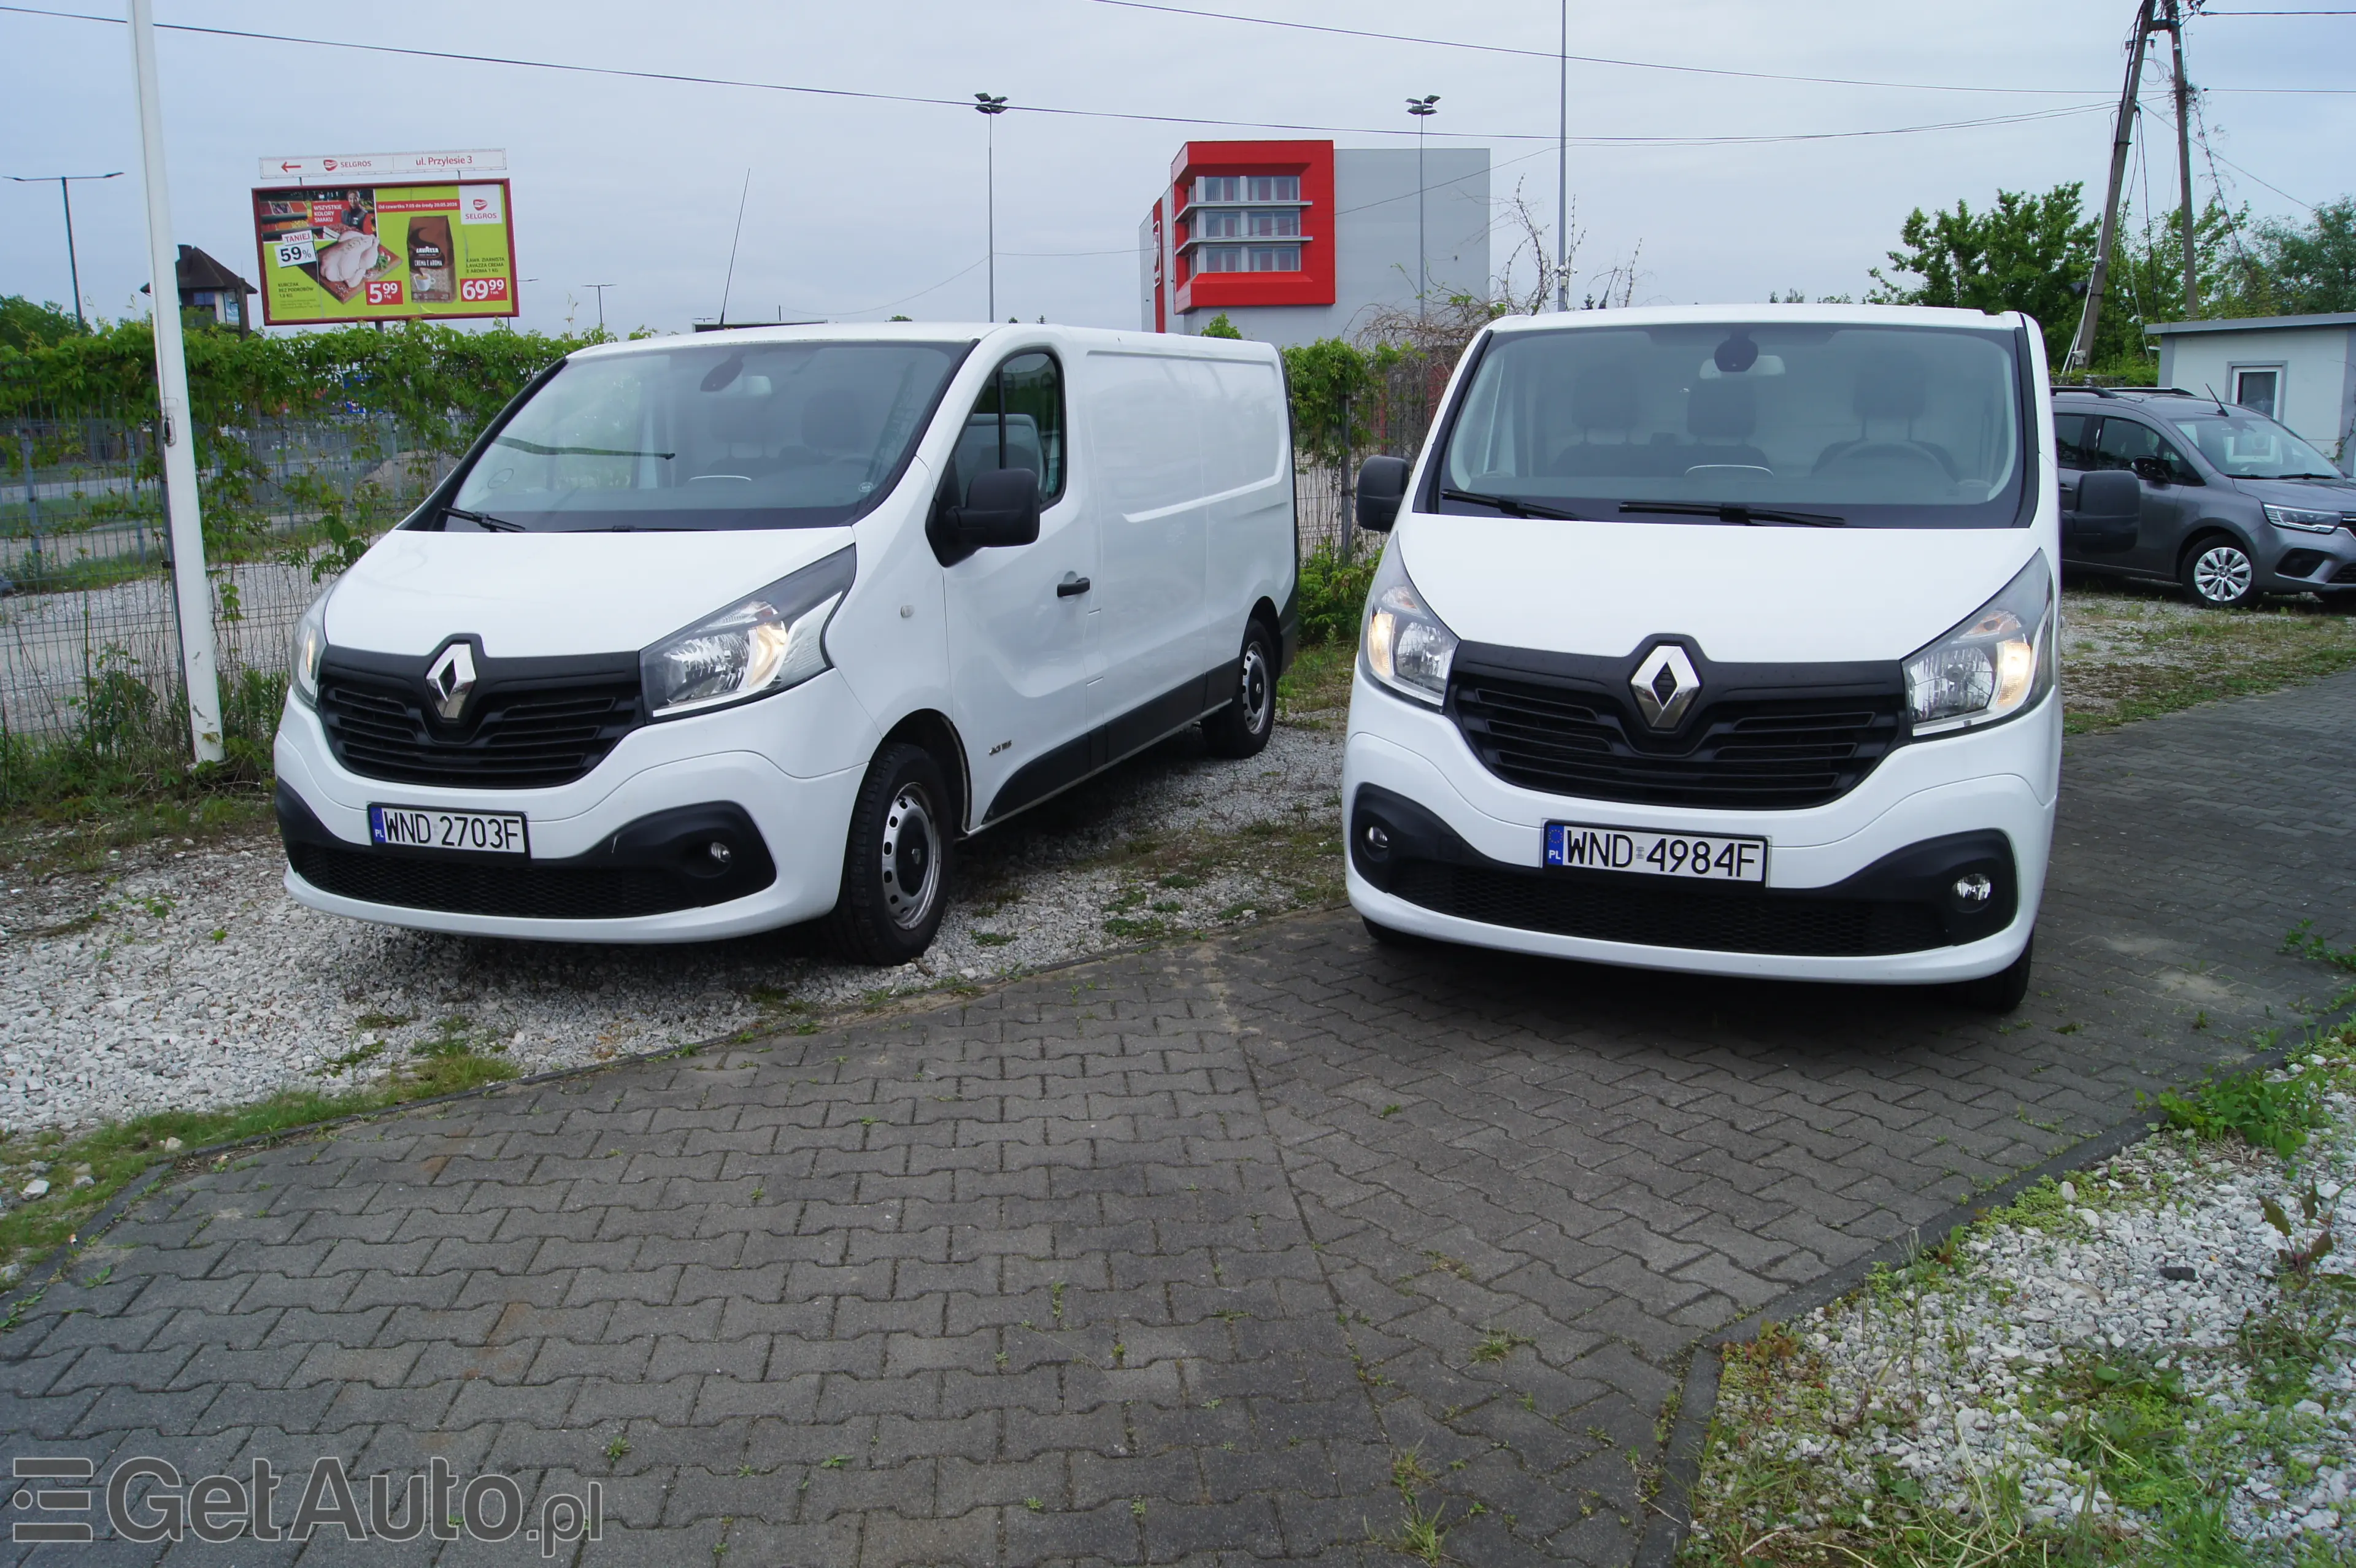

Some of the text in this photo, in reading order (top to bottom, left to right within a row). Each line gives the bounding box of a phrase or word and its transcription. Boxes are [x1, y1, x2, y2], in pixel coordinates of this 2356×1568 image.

[416, 156, 426, 166] ul.
[428, 155, 465, 167] Przylesie
[284, 233, 310, 243] TANIEJ
[375, 829, 384, 838] PL
[383, 810, 520, 850] WND 2703F
[1549, 850, 1561, 860] PL
[1567, 830, 1760, 877] WND 4984F
